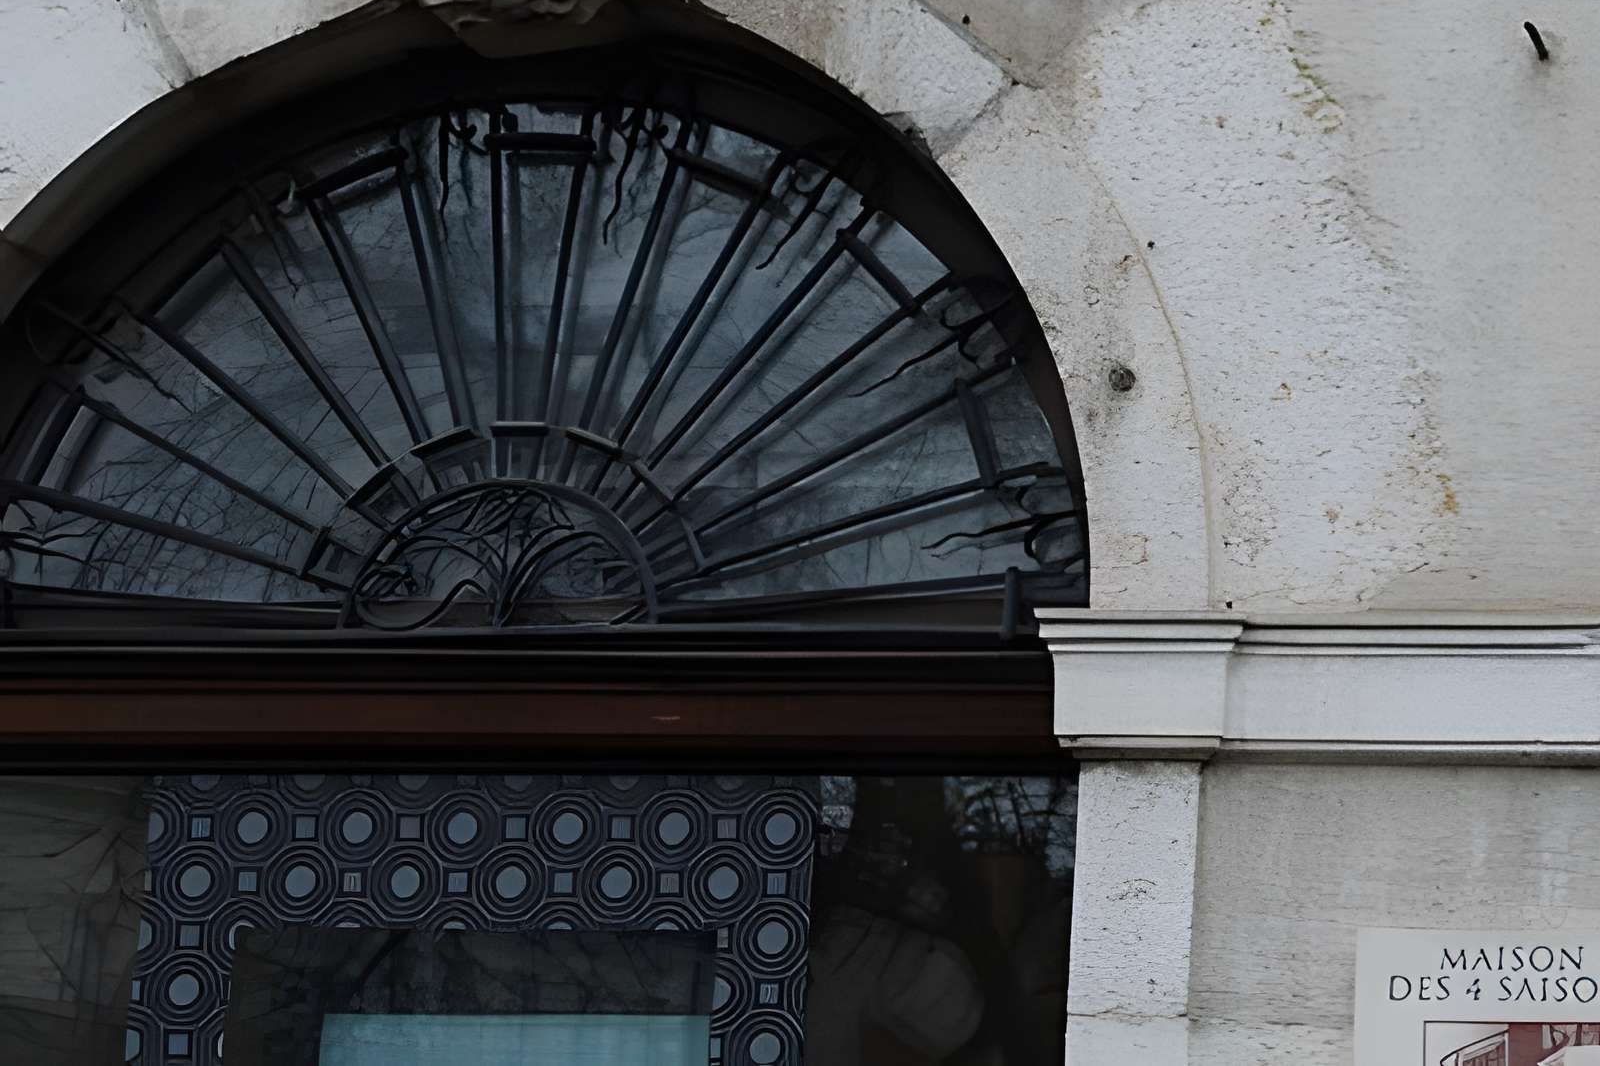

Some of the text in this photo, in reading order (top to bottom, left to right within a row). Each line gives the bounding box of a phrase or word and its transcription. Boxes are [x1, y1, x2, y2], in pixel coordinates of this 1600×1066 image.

[1440, 945, 1585, 972] MAISON
[1388, 975, 1451, 1001] DES
[1465, 977, 1482, 1001] 4
